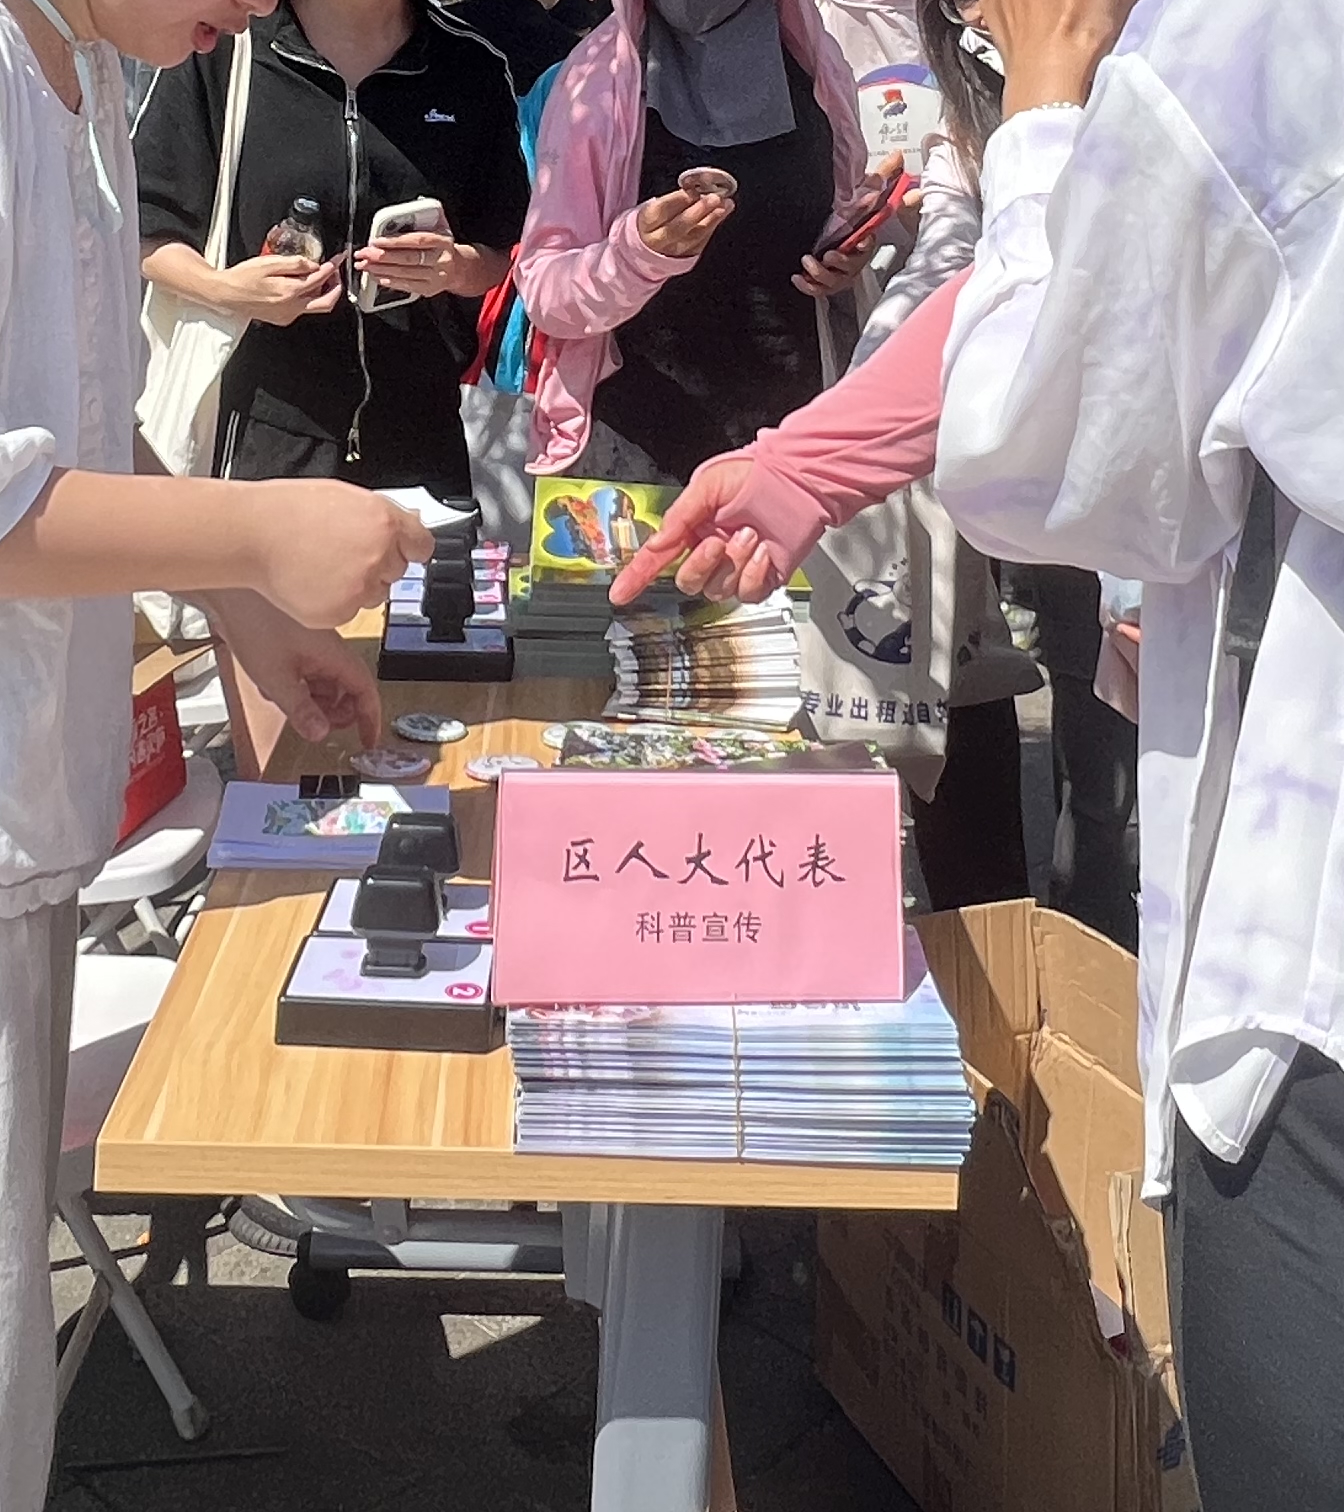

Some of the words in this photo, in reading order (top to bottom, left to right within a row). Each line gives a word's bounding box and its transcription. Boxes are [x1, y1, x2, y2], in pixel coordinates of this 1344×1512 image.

[563, 832, 847, 889] 区人大代表
[635, 911, 763, 945] 科普宣传
